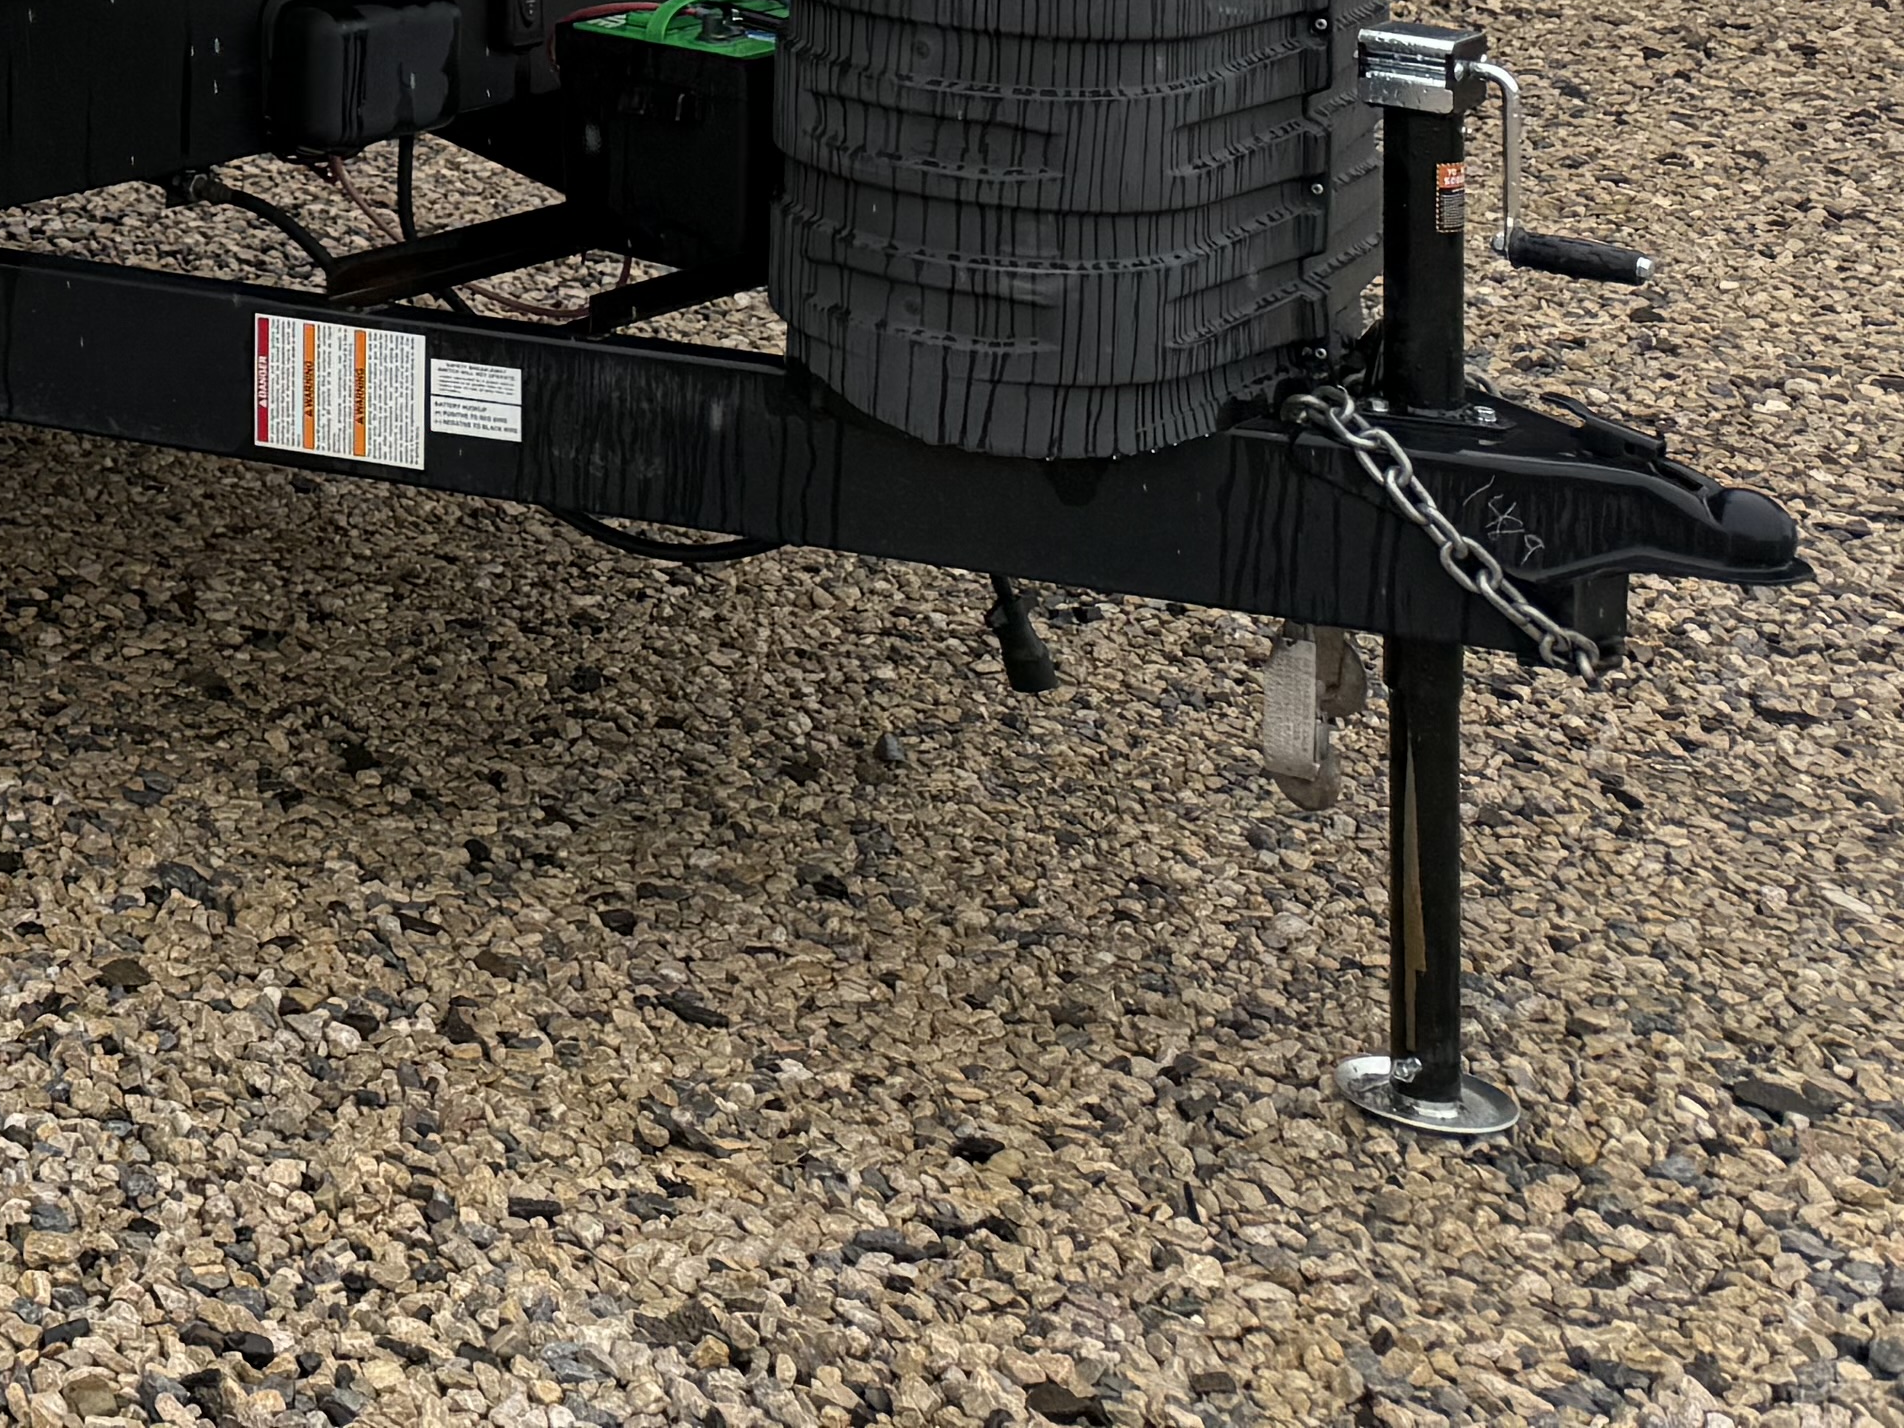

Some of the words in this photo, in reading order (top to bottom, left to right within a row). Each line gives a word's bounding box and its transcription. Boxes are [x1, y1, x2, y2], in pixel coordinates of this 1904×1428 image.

[258, 355, 268, 399] DANGER
[304, 360, 313, 409] WARNING
[355, 368, 365, 418] WARNING
